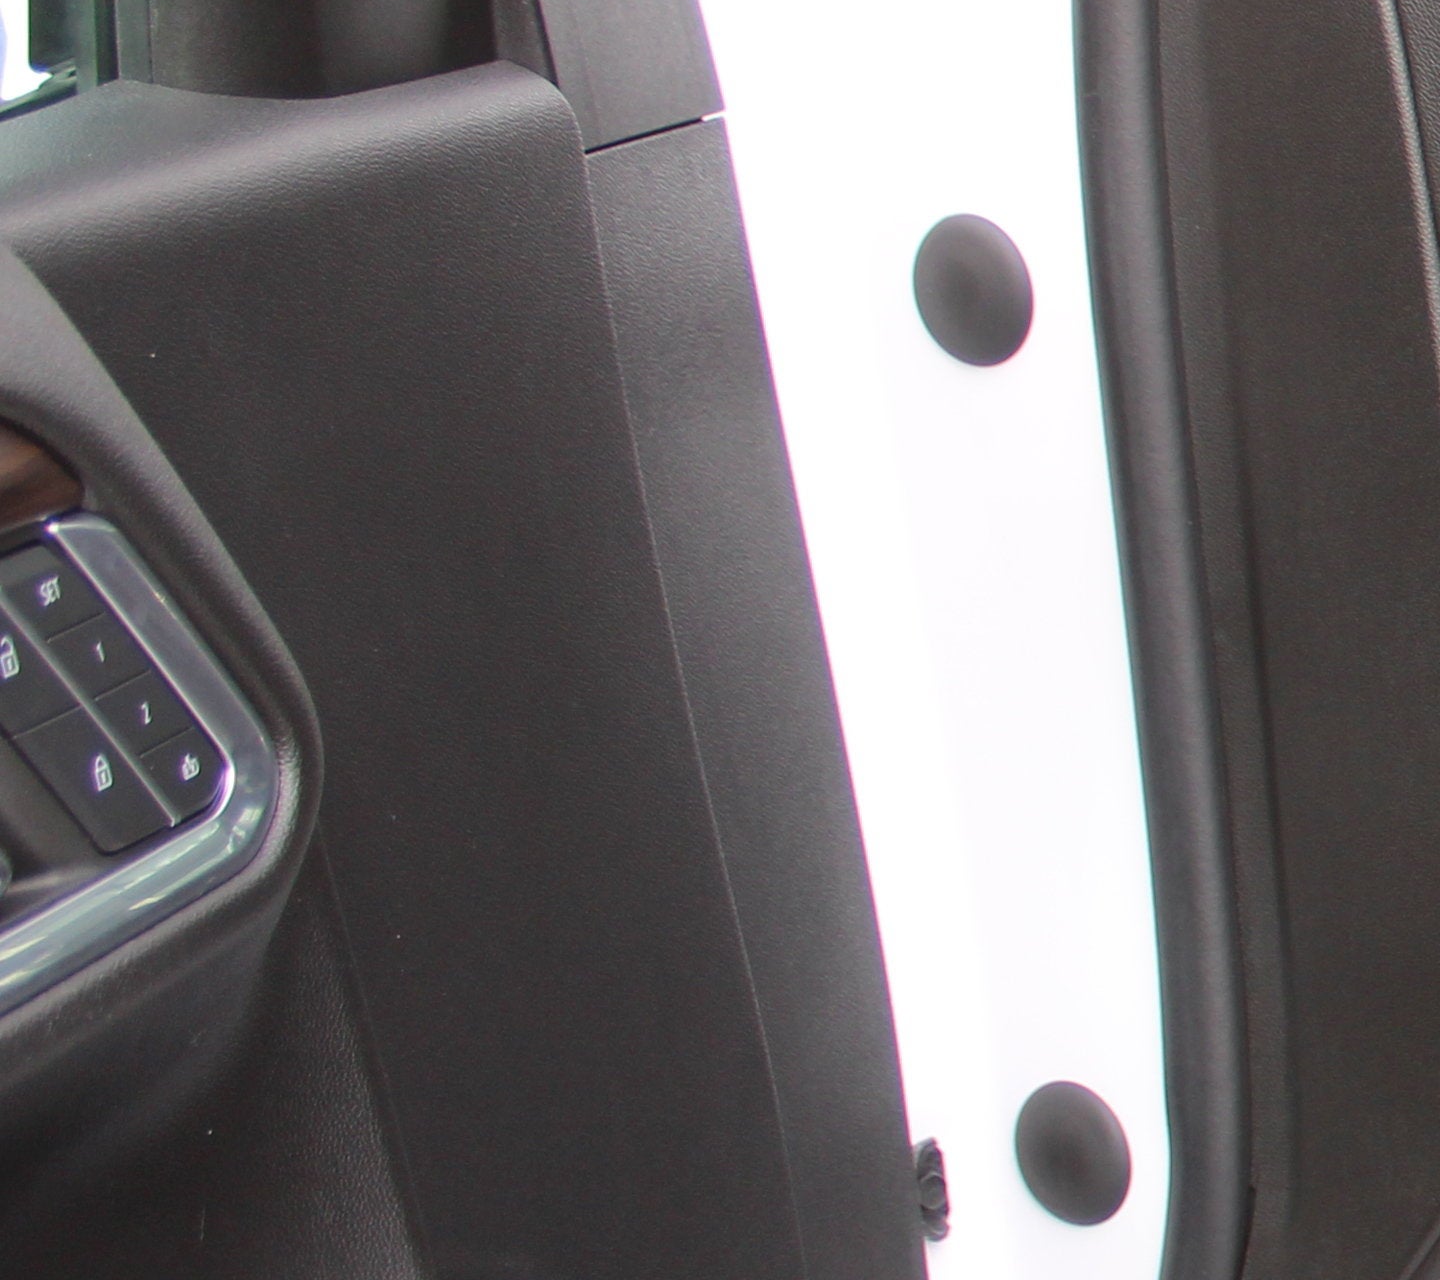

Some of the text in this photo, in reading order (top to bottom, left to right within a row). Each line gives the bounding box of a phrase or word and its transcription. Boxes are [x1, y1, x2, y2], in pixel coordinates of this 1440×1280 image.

[38, 575, 62, 606] SET
[96, 641, 106, 663] 1
[140, 701, 152, 726] 2
